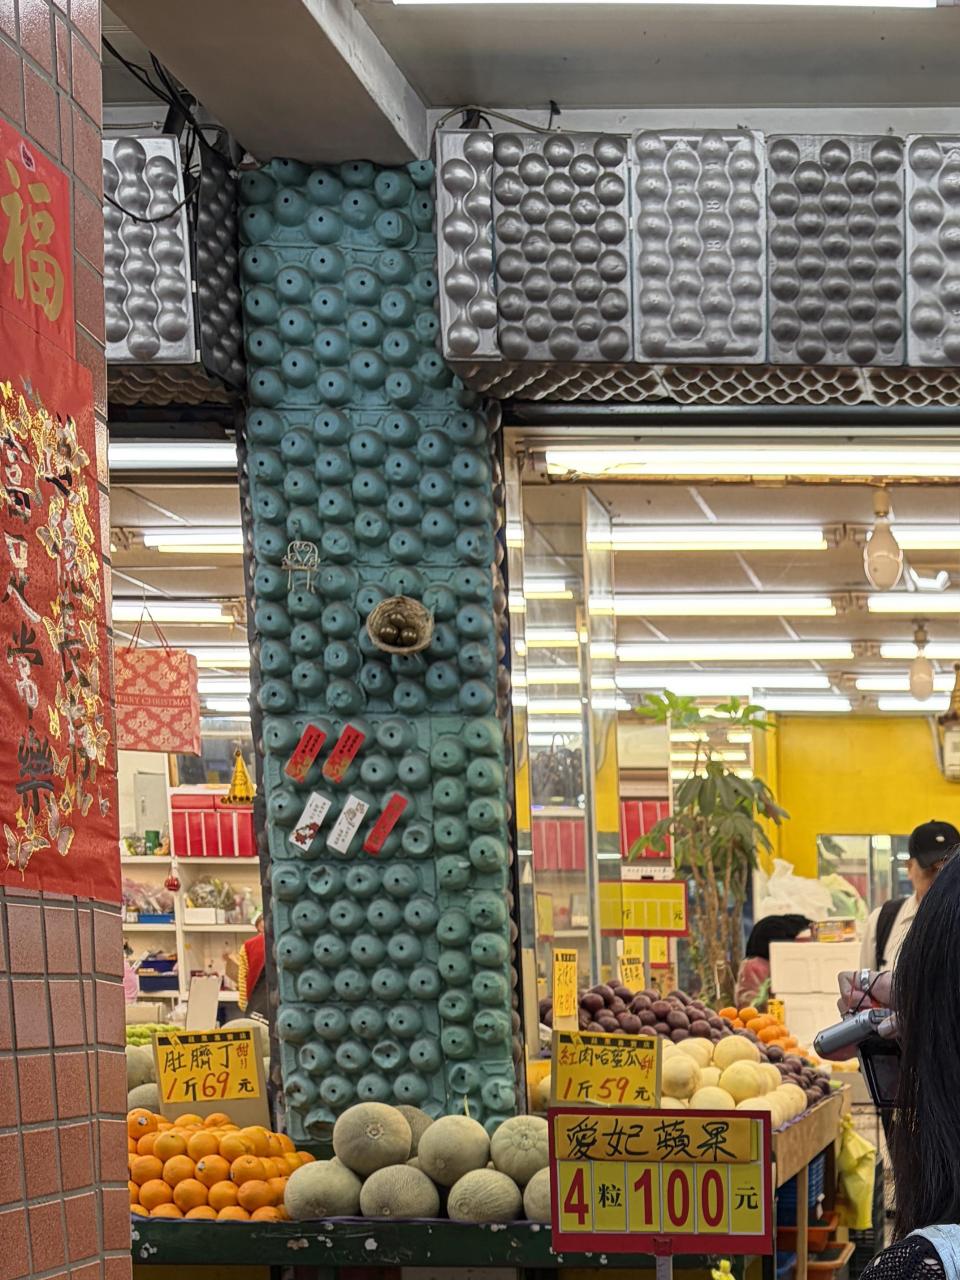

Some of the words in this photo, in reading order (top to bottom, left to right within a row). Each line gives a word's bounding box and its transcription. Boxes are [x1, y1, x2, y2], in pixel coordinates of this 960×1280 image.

[1, 158, 65, 322] 福
[117, 694, 139, 704] ERRY
[141, 695, 190, 706] CHRISTMAS
[565, 1116, 738, 1162] 愛妃蘋果
